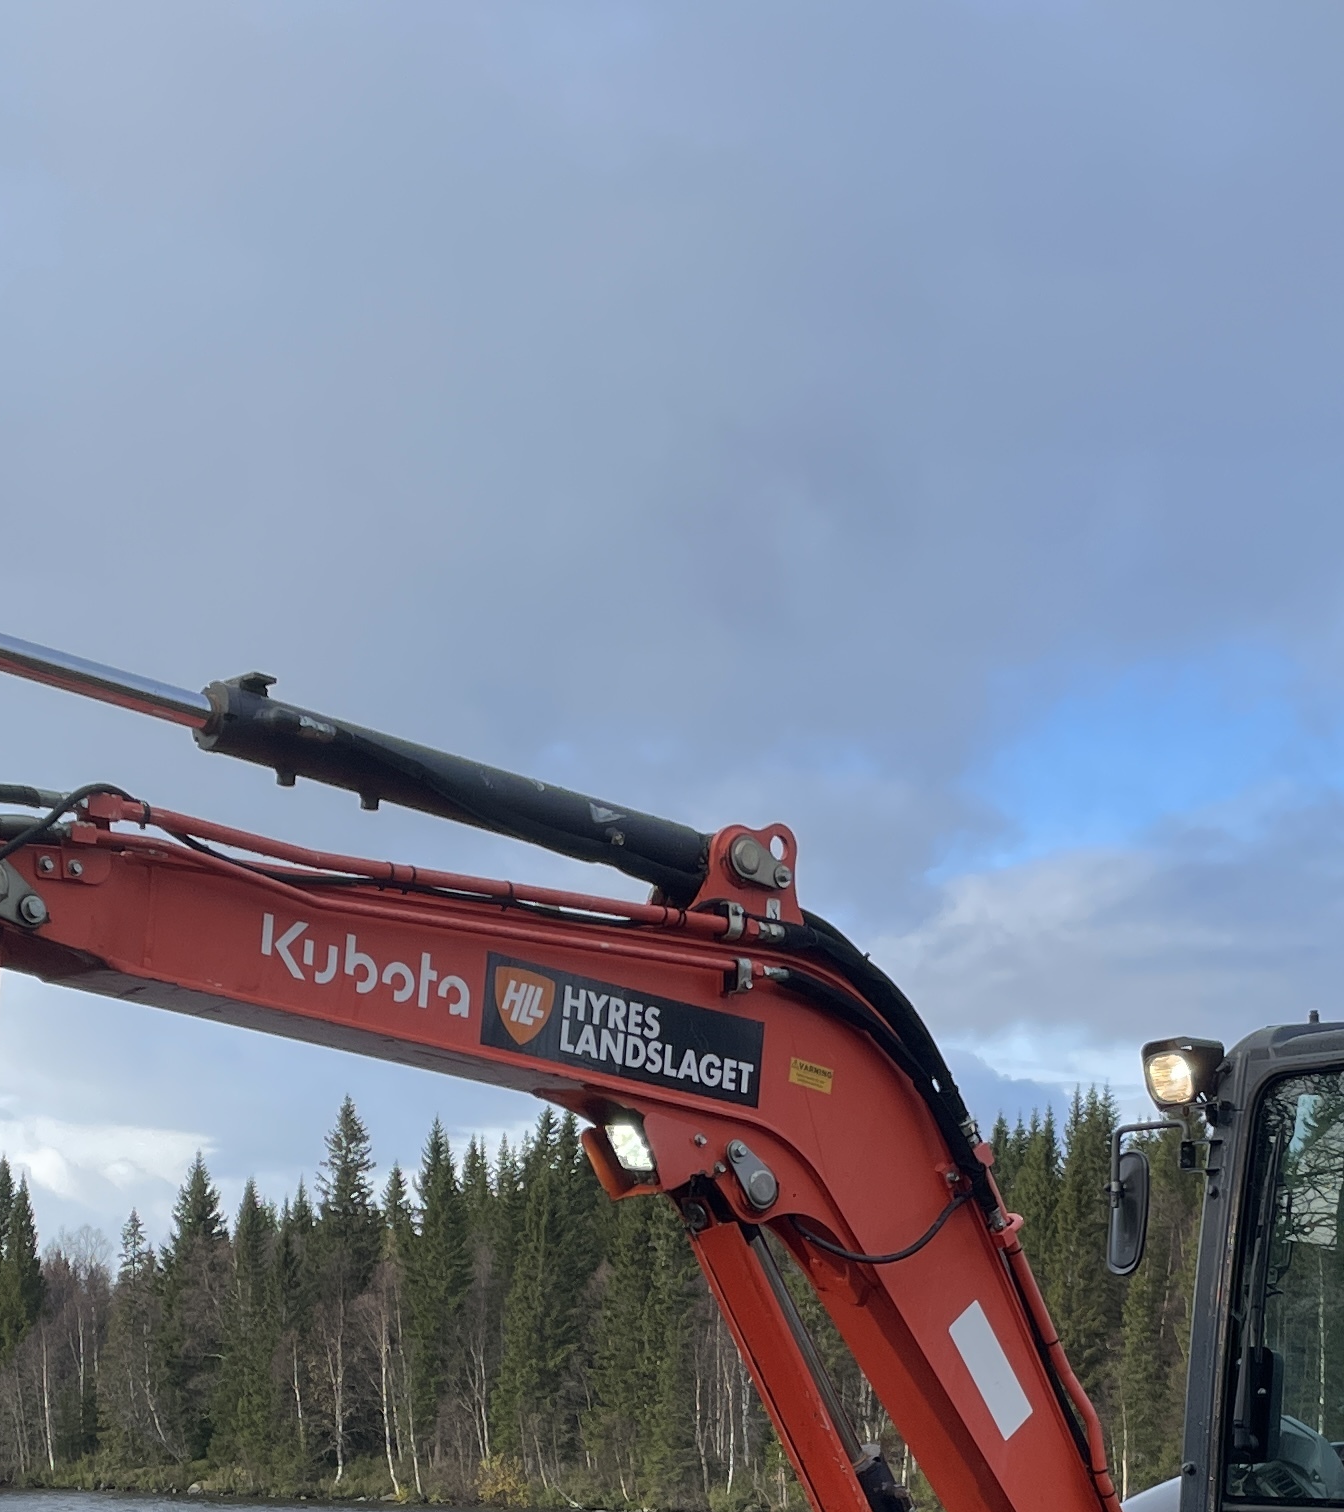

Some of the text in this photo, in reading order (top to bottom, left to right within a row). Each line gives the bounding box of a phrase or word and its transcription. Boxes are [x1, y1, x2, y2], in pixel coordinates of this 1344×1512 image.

[261, 912, 470, 1018] Kubota
[562, 985, 661, 1040] HYRES
[559, 1018, 754, 1094] LANDSLAGET
